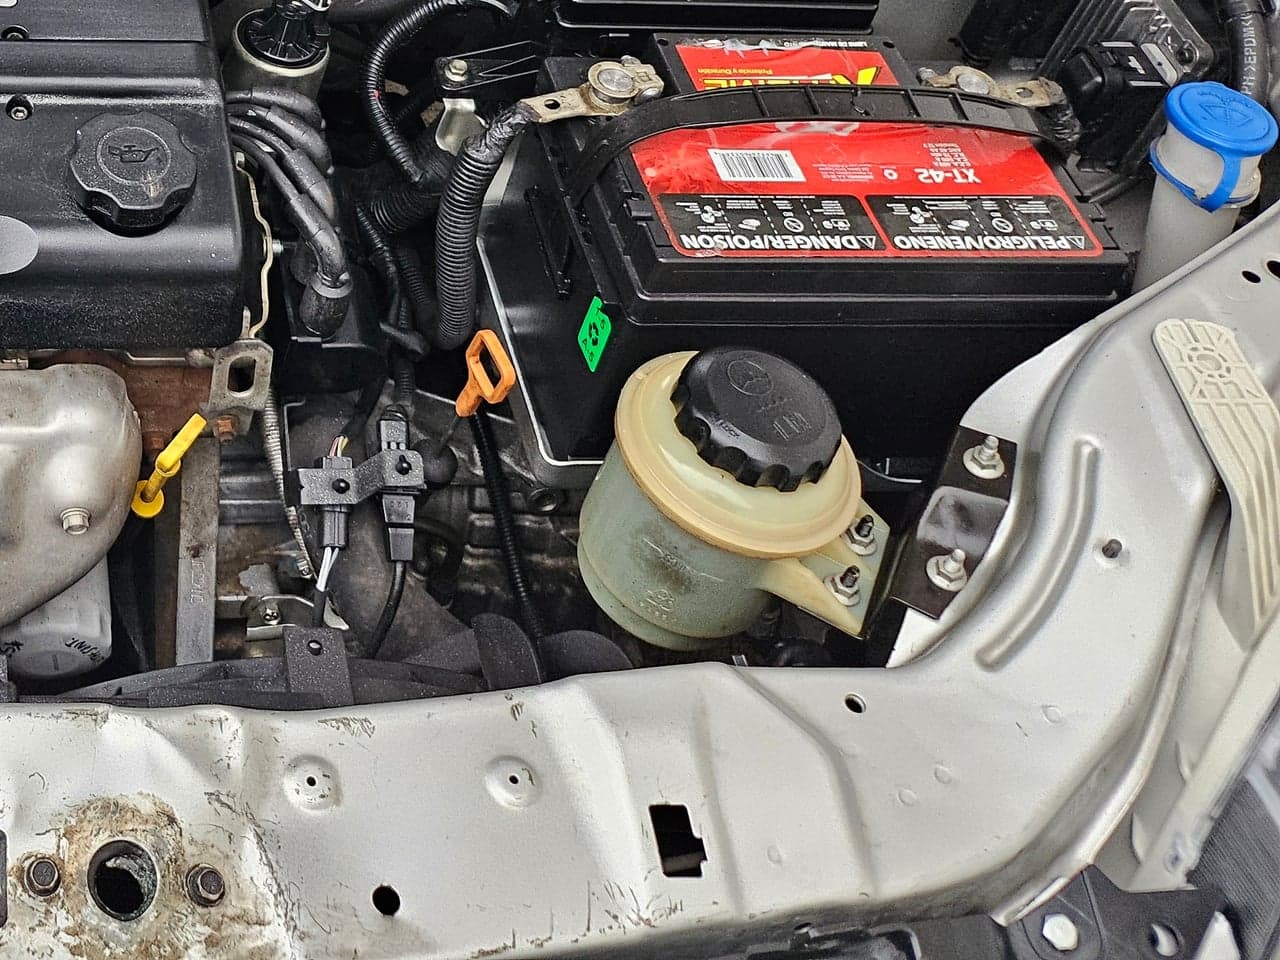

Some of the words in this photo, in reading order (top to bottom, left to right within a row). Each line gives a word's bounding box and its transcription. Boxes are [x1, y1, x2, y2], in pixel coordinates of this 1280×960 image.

[913, 167, 982, 184] XT-42
[679, 234, 861, 250] DANGER/POISON
[894, 235, 1071, 250] PELIGRO/VENENO
